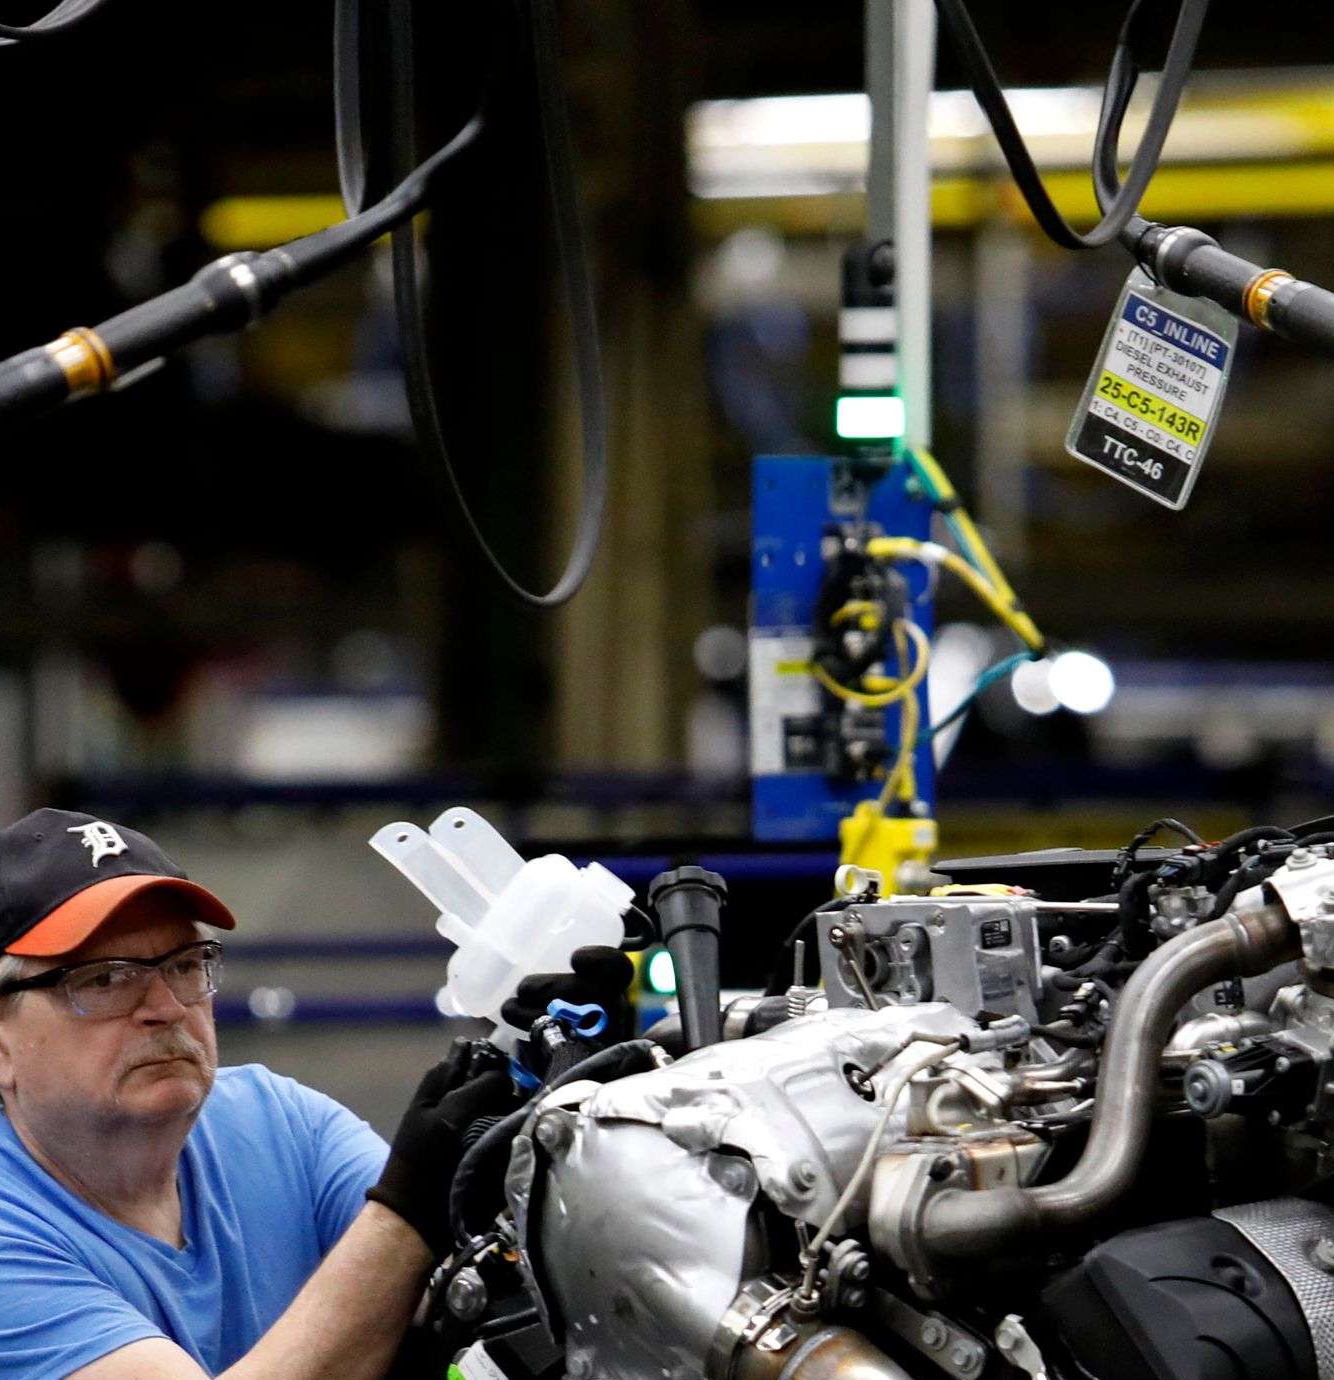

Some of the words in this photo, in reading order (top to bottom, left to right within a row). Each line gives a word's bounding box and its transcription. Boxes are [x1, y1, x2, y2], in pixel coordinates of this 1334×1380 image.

[1115, 340, 1154, 368] DIESEL
[1156, 362, 1209, 395] EXHAUST
[1127, 364, 1188, 402] PRESSURE
[1099, 376, 1200, 442] 25-C5-143R
[1103, 435, 1164, 480] TTC-46
[66, 820, 129, 868] D
